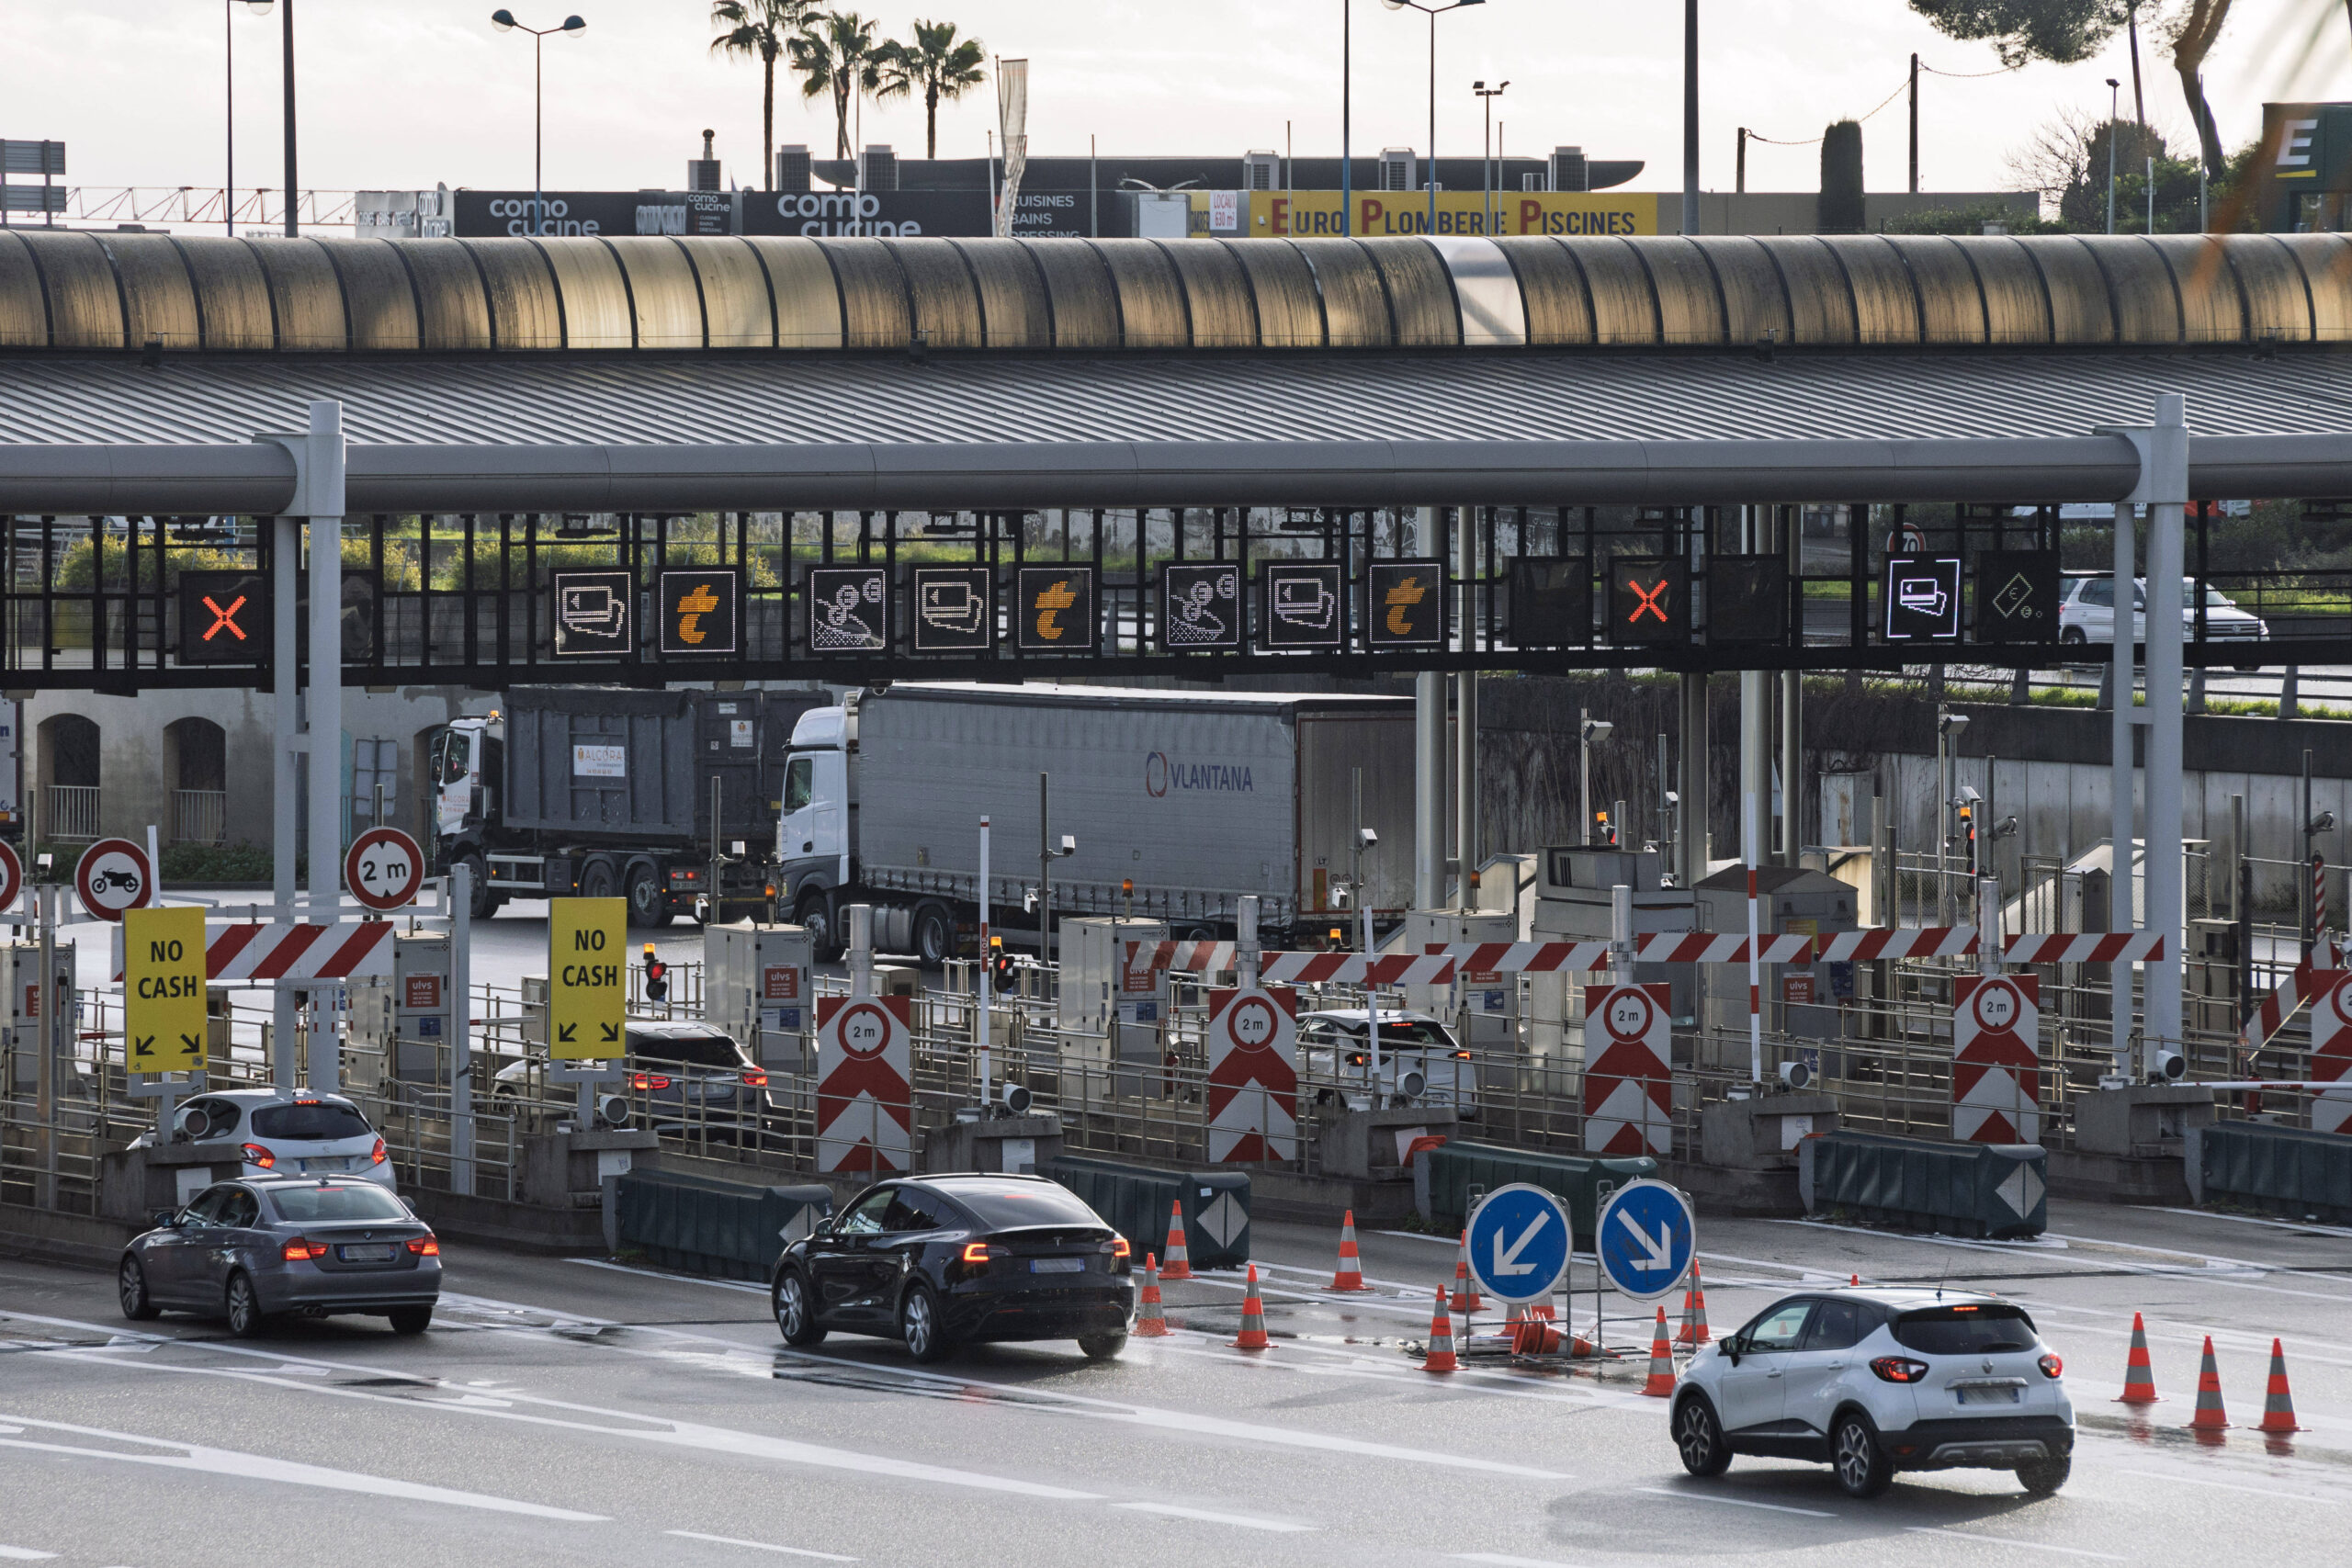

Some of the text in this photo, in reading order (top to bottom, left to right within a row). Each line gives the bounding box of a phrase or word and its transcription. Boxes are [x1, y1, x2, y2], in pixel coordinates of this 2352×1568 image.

[687, 194, 718, 203] como
[777, 194, 880, 219] como
[1014, 195, 1074, 208] UISINES
[1214, 193, 1237, 209] LOCAUX
[490, 198, 568, 218] como
[695, 203, 730, 212] cucine
[1215, 211, 1227, 227] 630
[1272, 198, 1636, 235] EURO PLOMBERIE PISCINES
[507, 220, 599, 237] cucine
[800, 220, 922, 237] cucine
[1170, 763, 1253, 792] VLANTANA
[362, 860, 406, 882] 2 m
[575, 929, 605, 951] NO
[151, 940, 183, 963] NO
[562, 965, 617, 987] CASH
[771, 972, 790, 981] ulys
[138, 976, 198, 999] CASH
[413, 980, 433, 990] ulys
[1789, 982, 1808, 990] ulys
[1987, 1001, 2007, 1012] 2 m
[1619, 1010, 1638, 1021] 2 m
[854, 1026, 875, 1038] 2 m
[1243, 1018, 1263, 1030] 2 m
